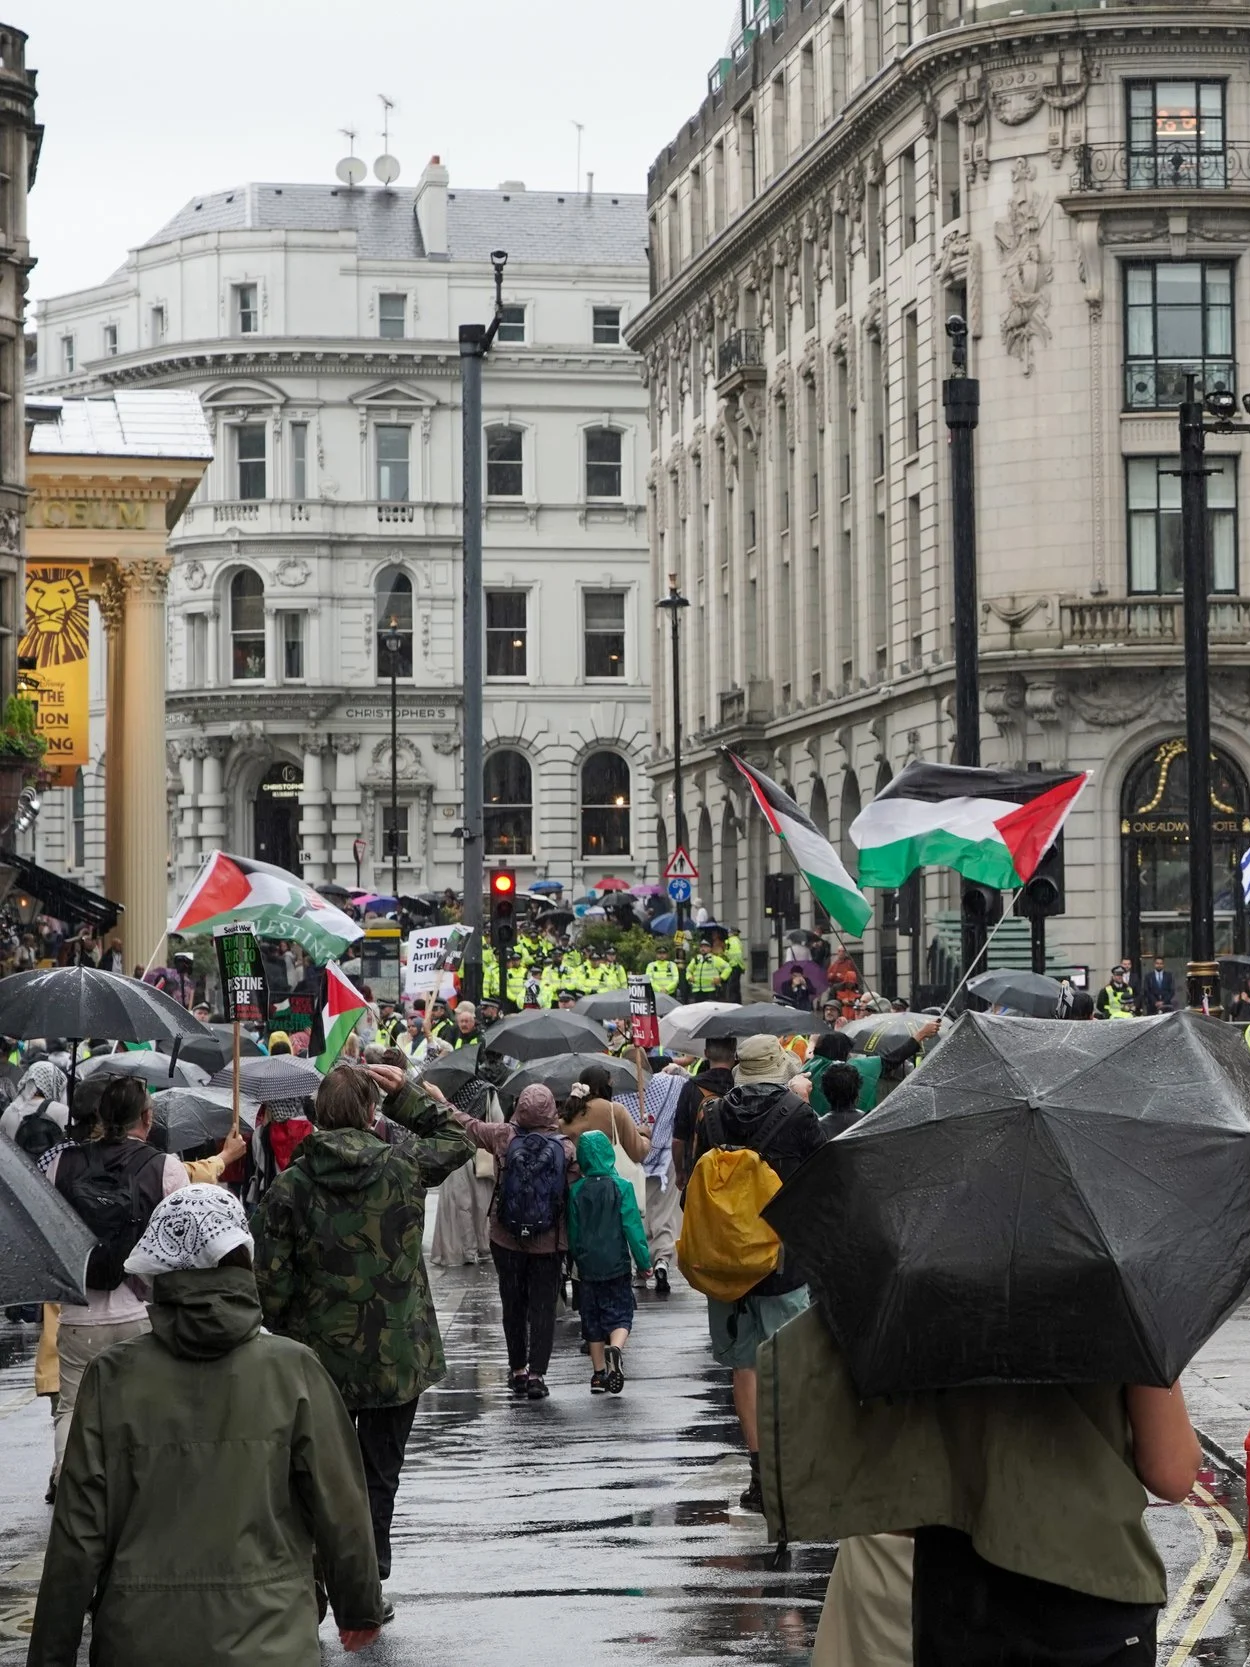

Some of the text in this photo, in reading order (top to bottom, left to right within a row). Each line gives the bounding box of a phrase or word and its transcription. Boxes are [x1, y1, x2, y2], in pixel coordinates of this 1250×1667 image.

[40, 690, 64, 703] THE
[46, 737, 73, 750] NG
[300, 852, 311, 861] 18
[416, 937, 448, 949] Stop
[236, 991, 251, 1004] BE
